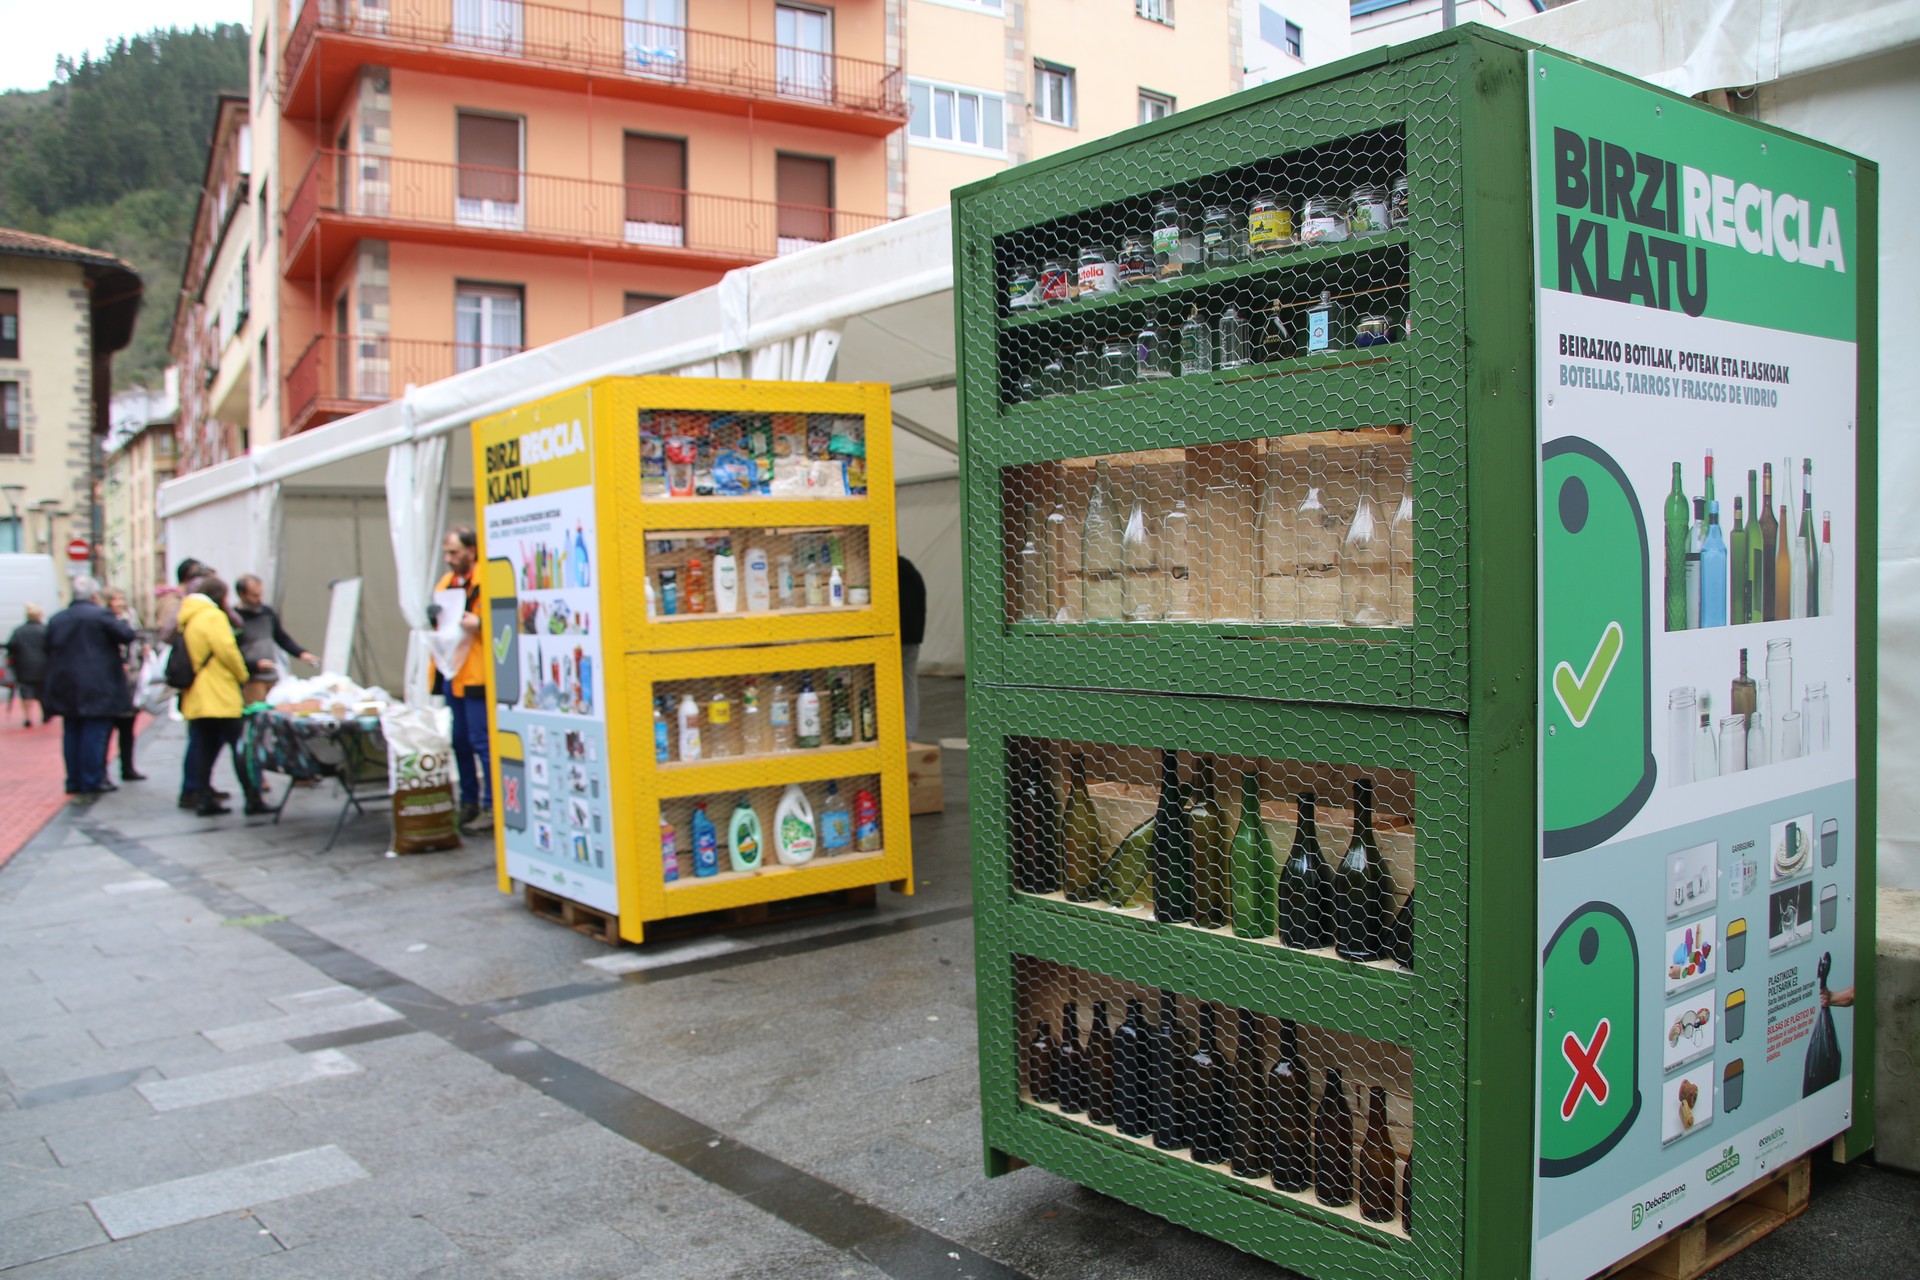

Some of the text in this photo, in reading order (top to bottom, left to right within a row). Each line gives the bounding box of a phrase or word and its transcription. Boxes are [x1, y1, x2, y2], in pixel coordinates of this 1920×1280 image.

[1554, 126, 1846, 273] BIRZI RECICLA
[1556, 212, 1708, 317] KLATU
[1559, 334, 1790, 384] BEIRAZKO BOTILAK, POTEAK ETA FLASKOAK
[1559, 364, 1777, 408] BOTELLAS, TARROS Y FRASCOS DE VIDRIO
[486, 438, 520, 473] BIRZI
[1645, 1184, 1686, 1212] DebaBarrena
